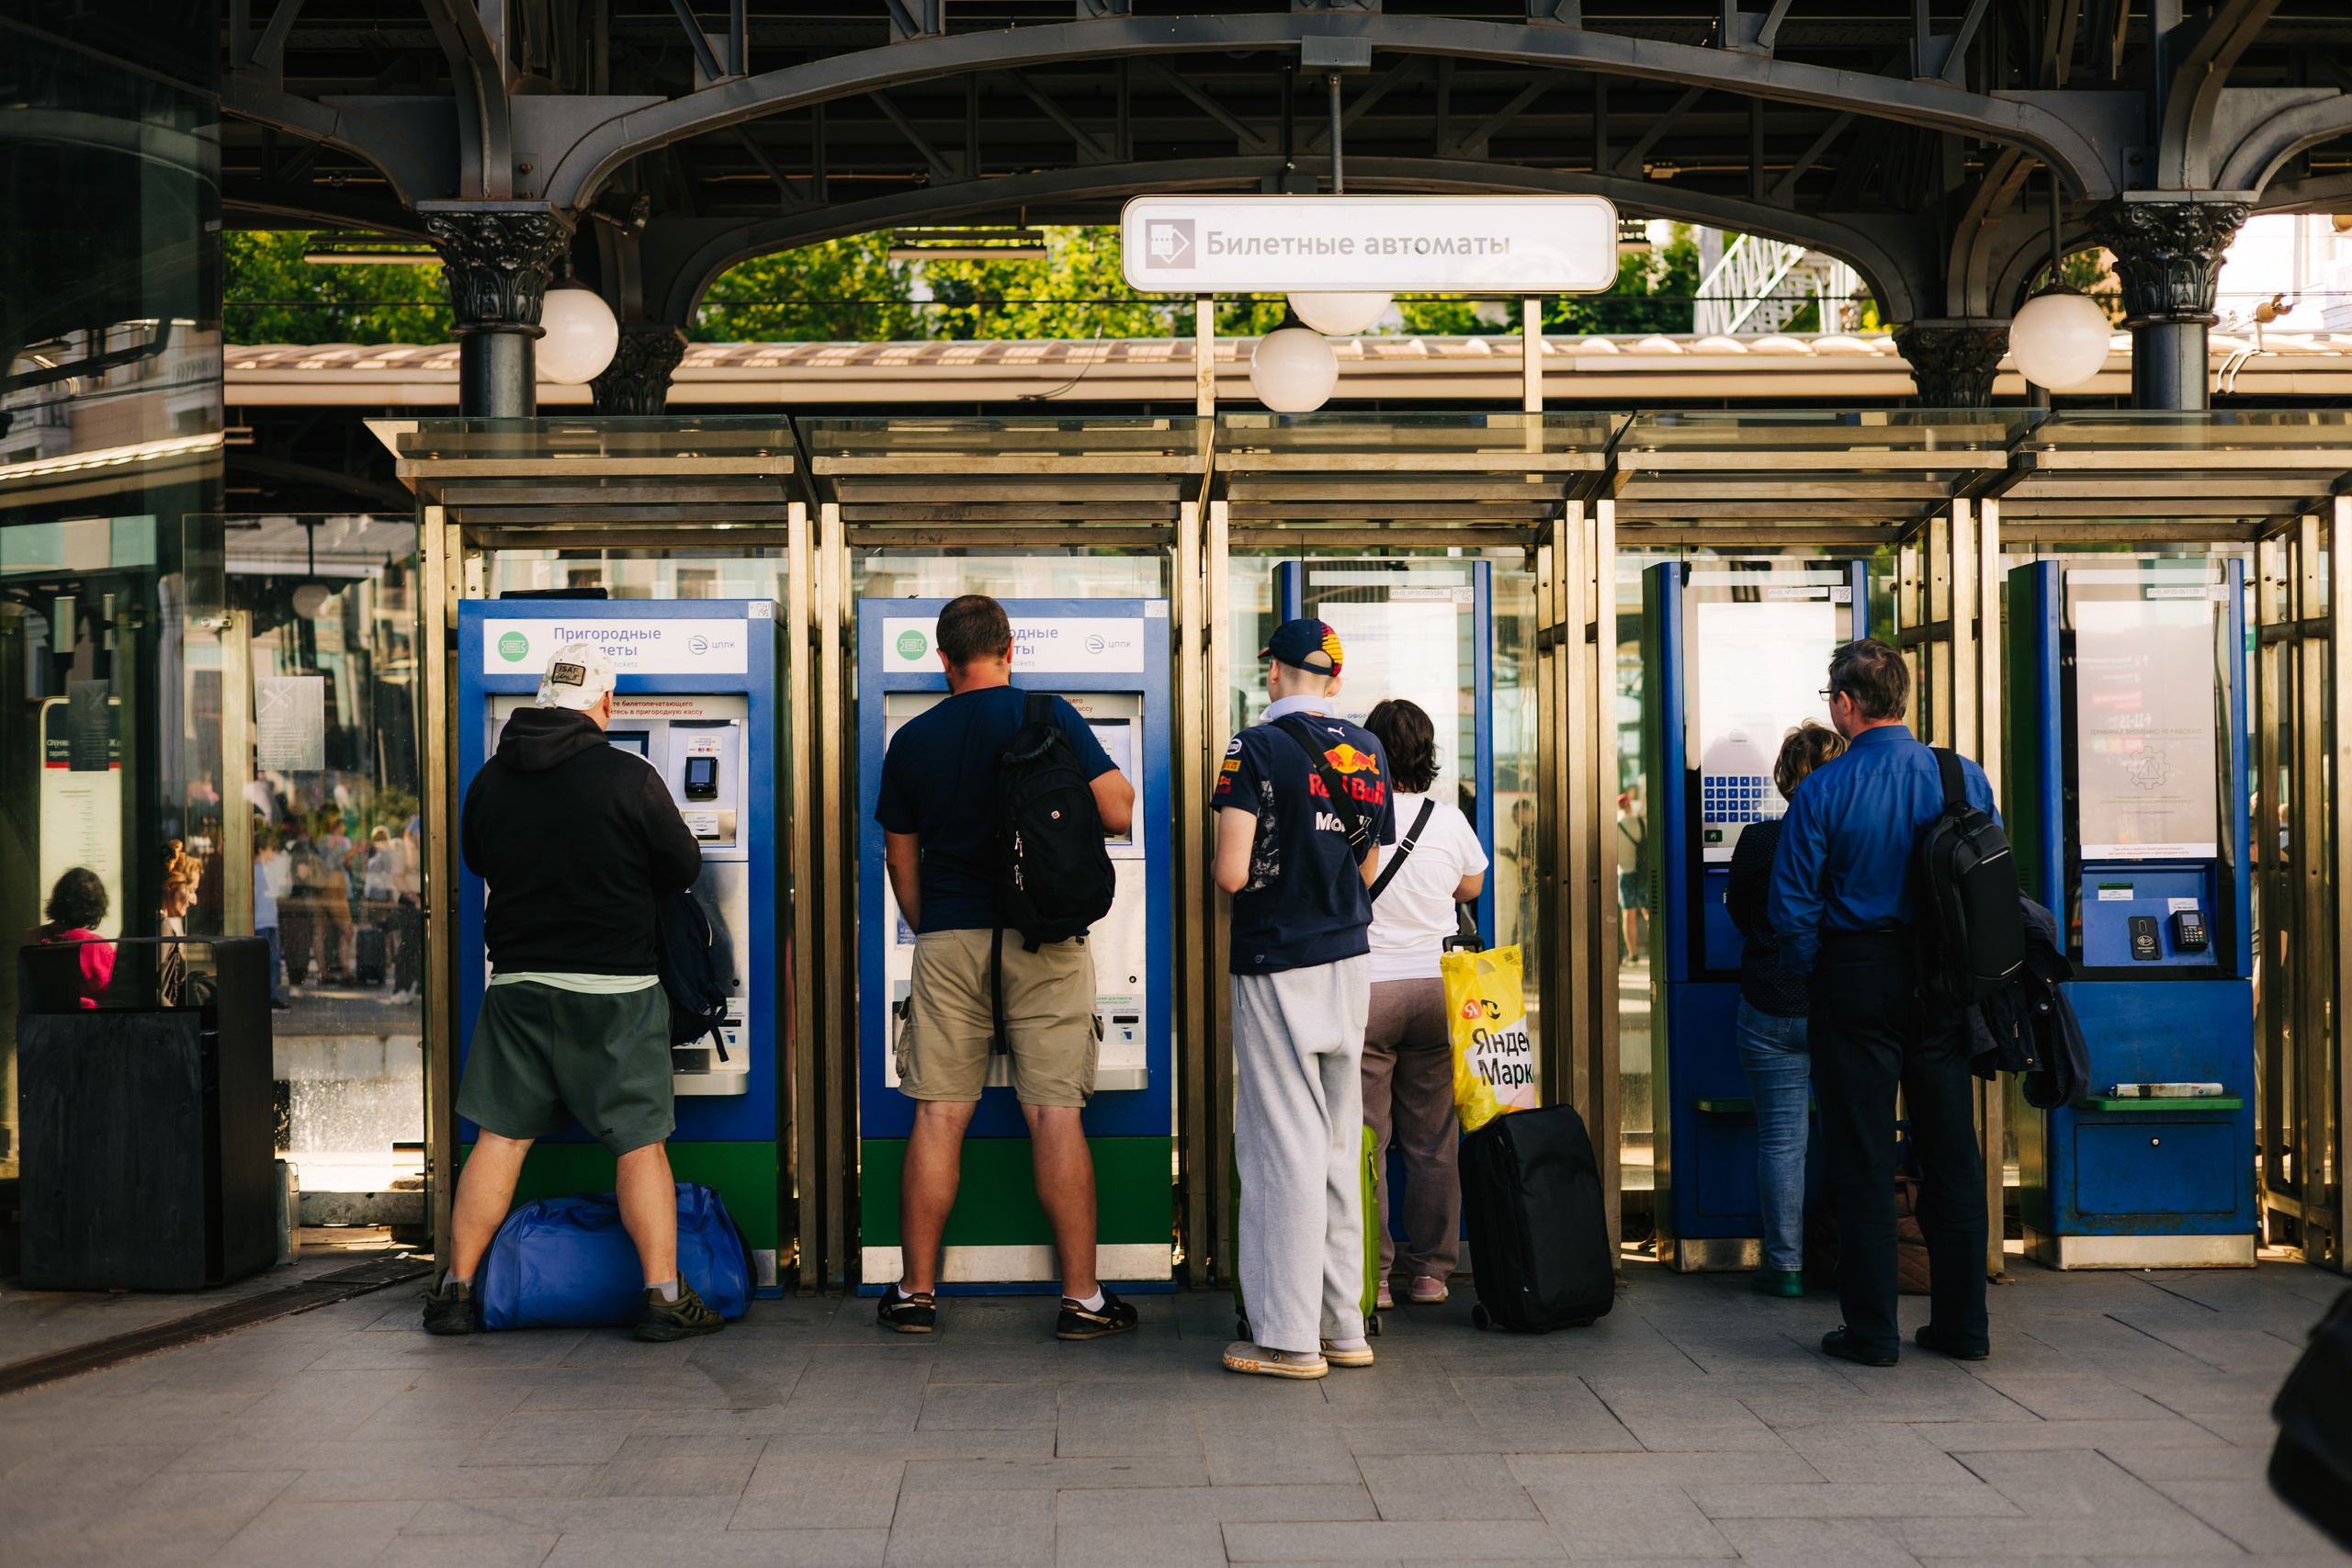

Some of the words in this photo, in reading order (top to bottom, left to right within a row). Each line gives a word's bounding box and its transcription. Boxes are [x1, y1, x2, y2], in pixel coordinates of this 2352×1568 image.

[1206, 231, 1355, 255] Билетные
[1364, 235, 1510, 255] автоматы
[554, 627, 662, 642] Пригородные
[1108, 640, 1131, 649] ЦППК
[559, 666, 579, 674] ISAF
[1351, 777, 1385, 806] Bull
[1226, 1357, 1260, 1371] crocs
